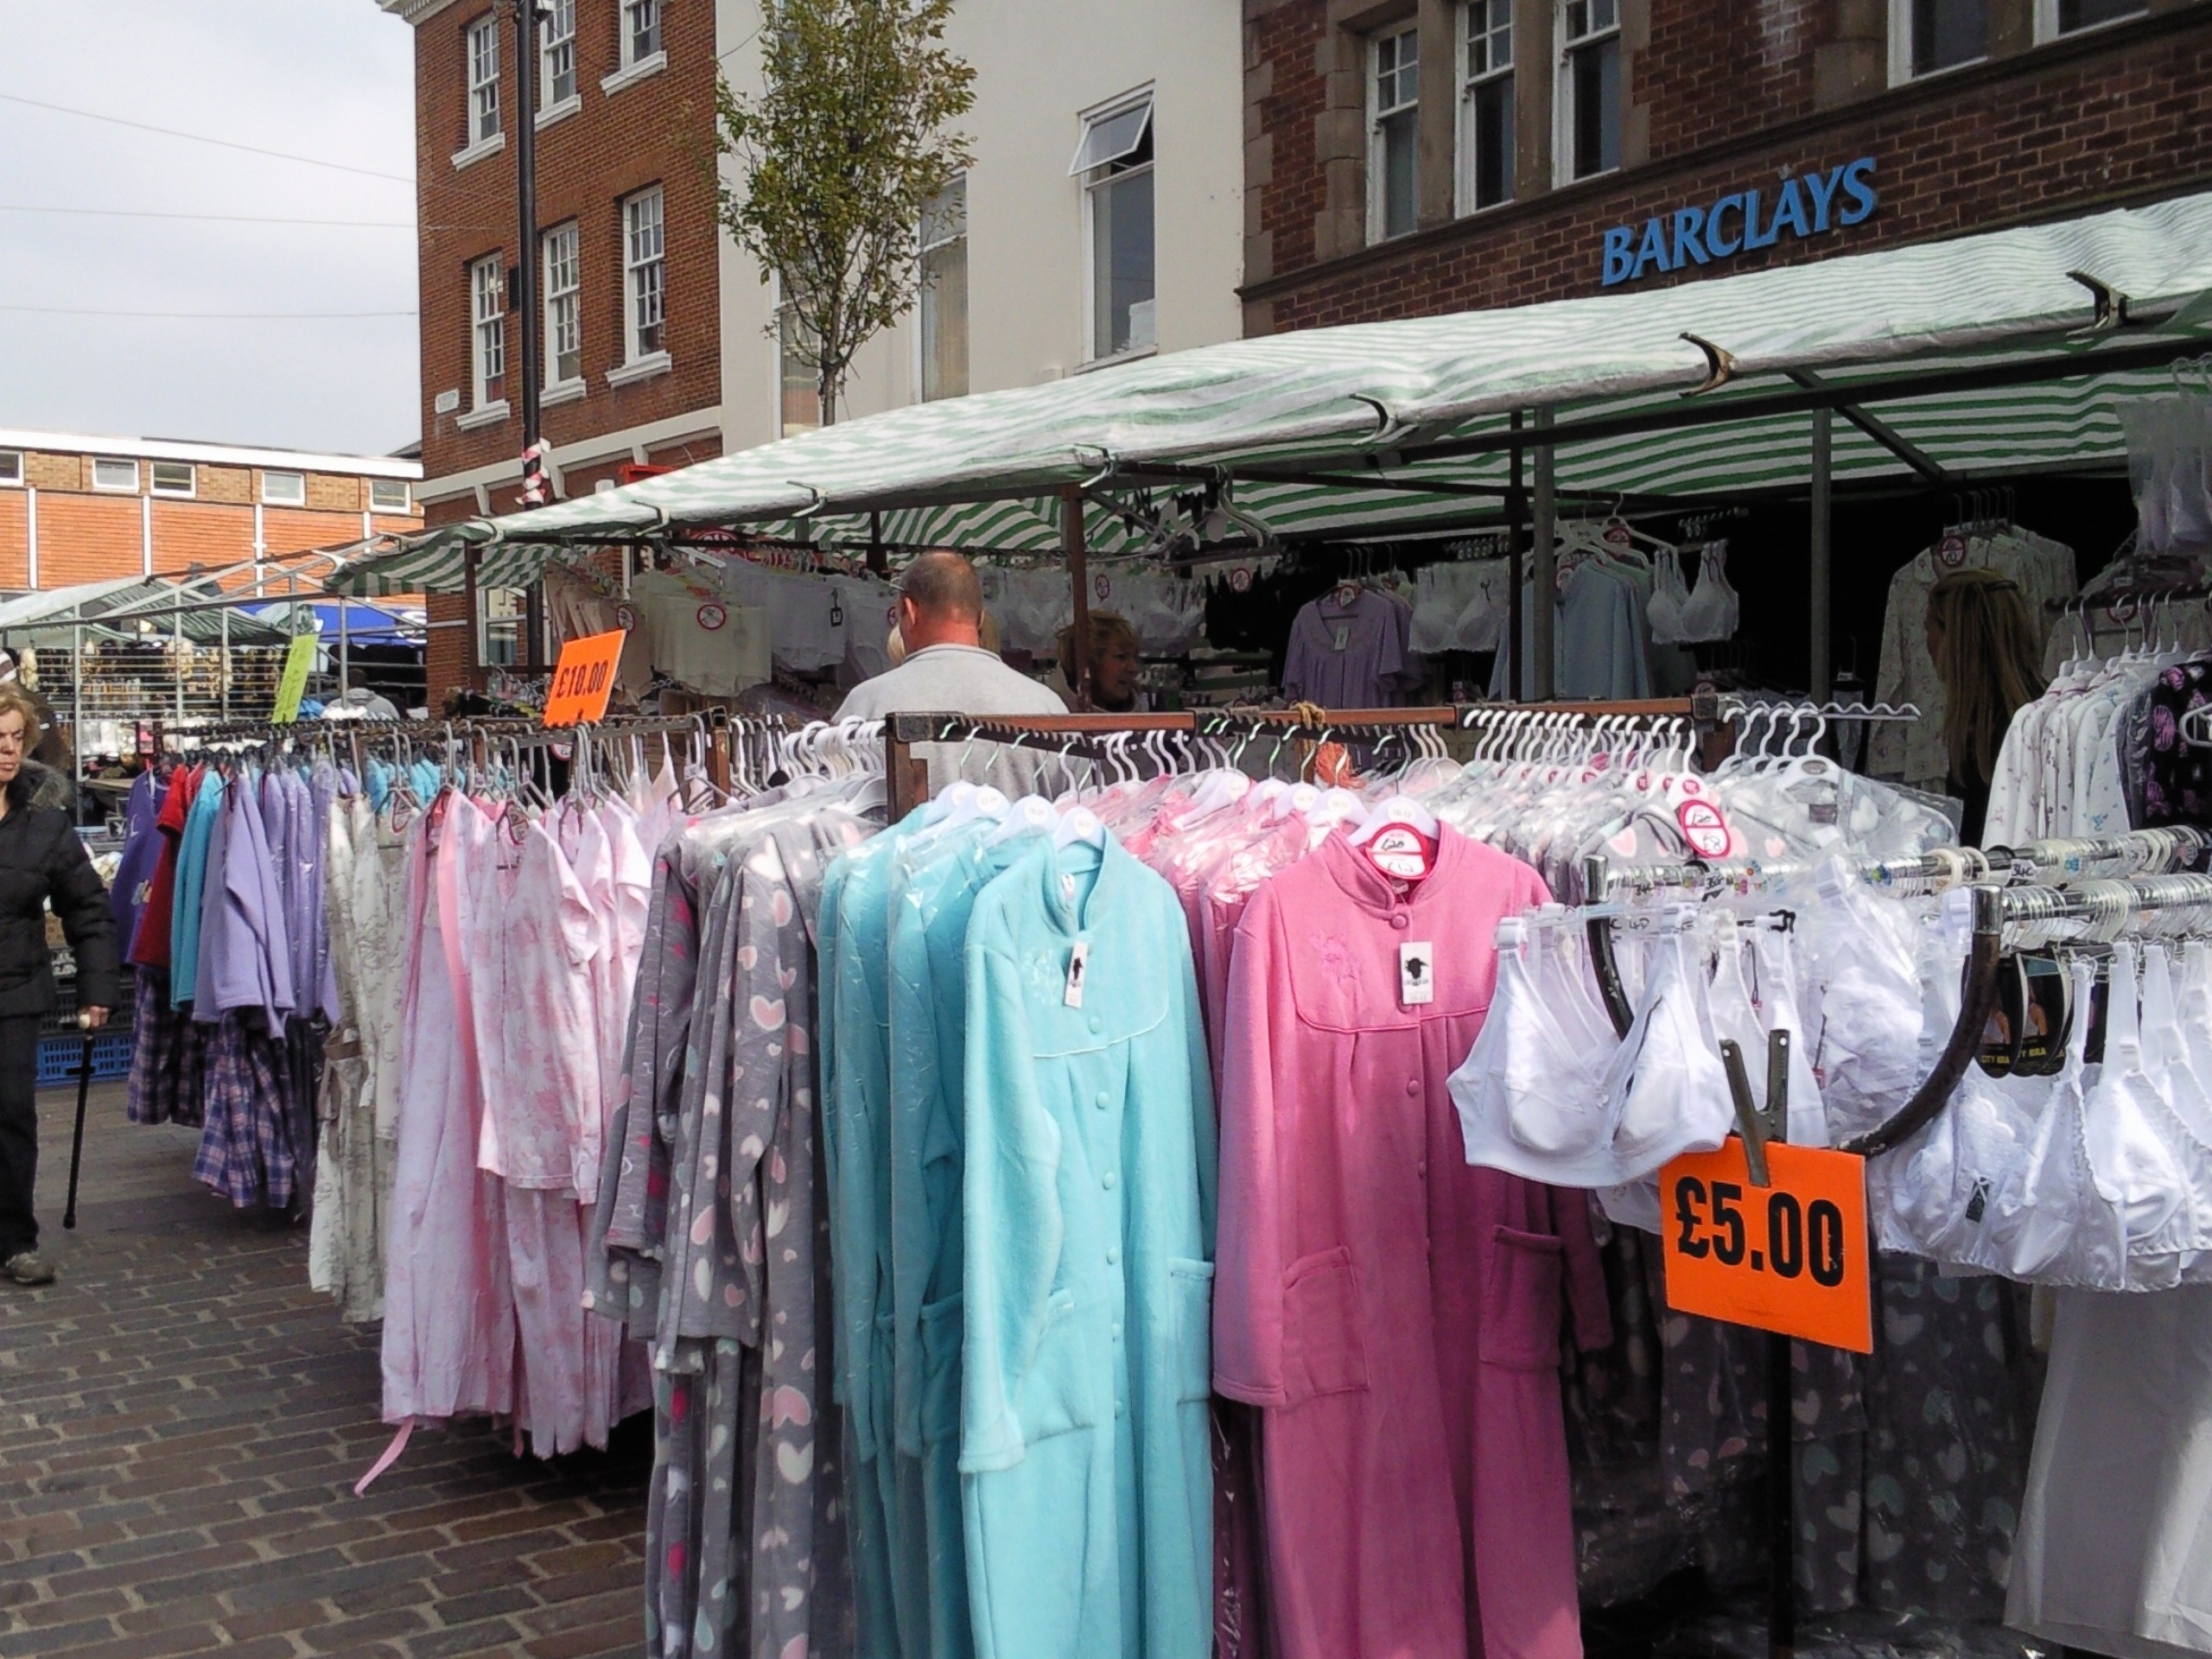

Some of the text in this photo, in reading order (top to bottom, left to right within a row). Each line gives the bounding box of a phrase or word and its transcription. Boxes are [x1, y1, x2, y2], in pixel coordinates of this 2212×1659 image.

[1601, 156, 1877, 286] BARCLAYS
[556, 659, 609, 698] £10.00
[1980, 1055, 2011, 1064] CITY BRA
[2028, 1046, 2047, 1058] BRA
[1675, 1175, 1845, 1287] £5.00
